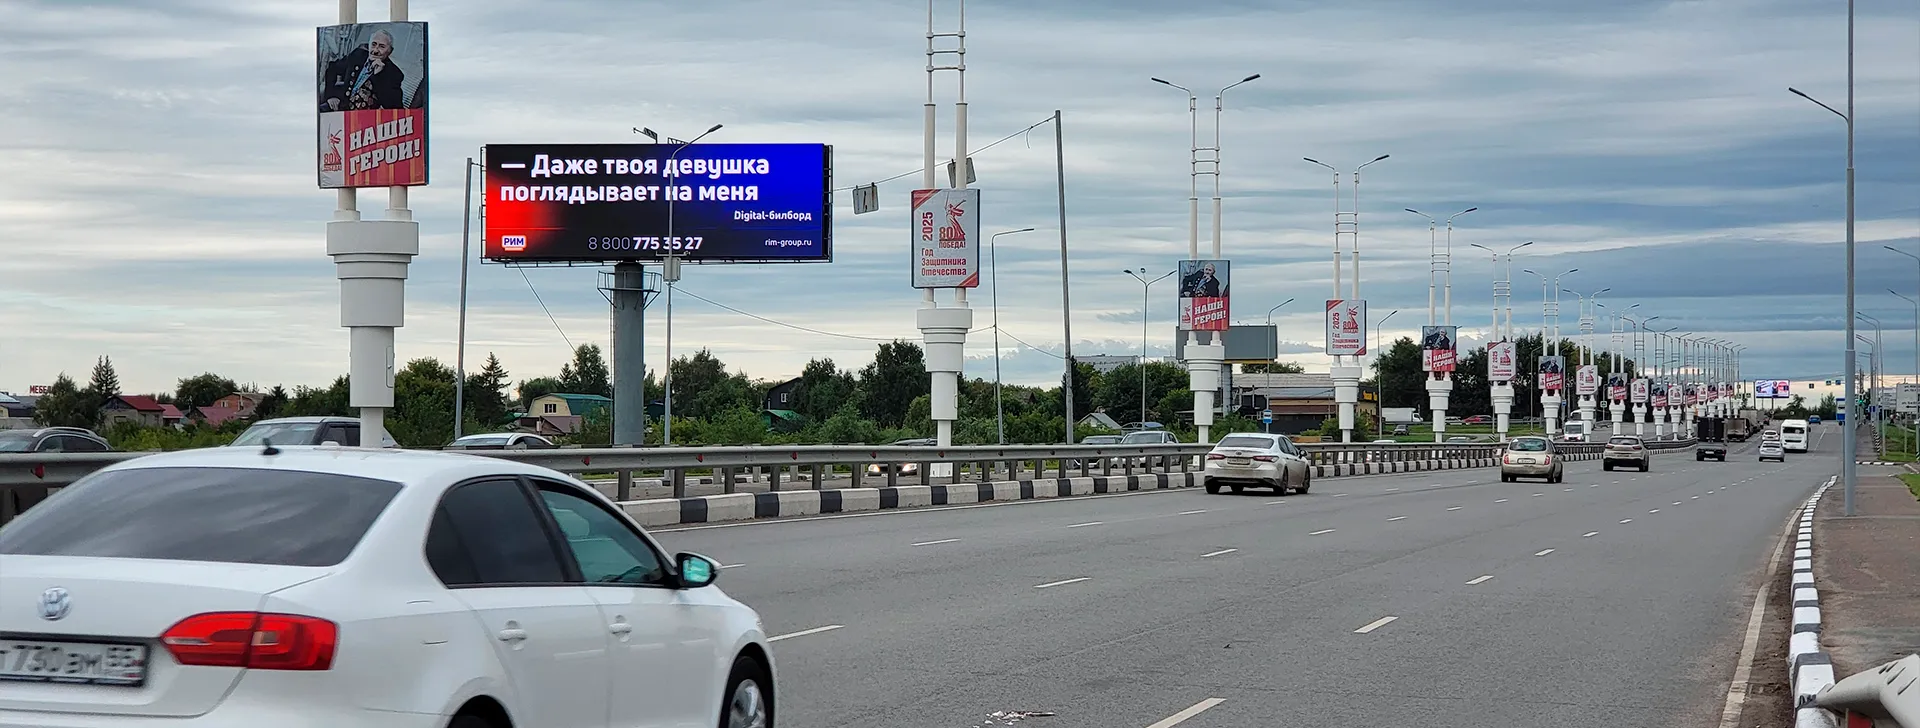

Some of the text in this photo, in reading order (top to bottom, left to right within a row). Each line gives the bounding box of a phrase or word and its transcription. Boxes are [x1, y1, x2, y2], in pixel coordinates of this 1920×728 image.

[349, 115, 413, 151] НАШИ
[349, 139, 420, 176] ГЕРОИ!
[530, 154, 598, 178] Даже
[602, 159, 658, 175] твоя
[663, 158, 770, 180] девушка
[501, 185, 759, 205] поглядывает на меня
[733, 210, 812, 222] Digital-билборд
[922, 211, 934, 241] 2025
[939, 226, 954, 239] 80
[503, 237, 525, 246] РИМ
[588, 236, 703, 250] 8 800 775 35 27
[764, 238, 812, 248] rim-group.ru
[938, 241, 966, 249] ПОБЕДА!
[921, 248, 934, 257] Год
[921, 258, 967, 267] Защитника
[921, 268, 967, 276] Отечества
